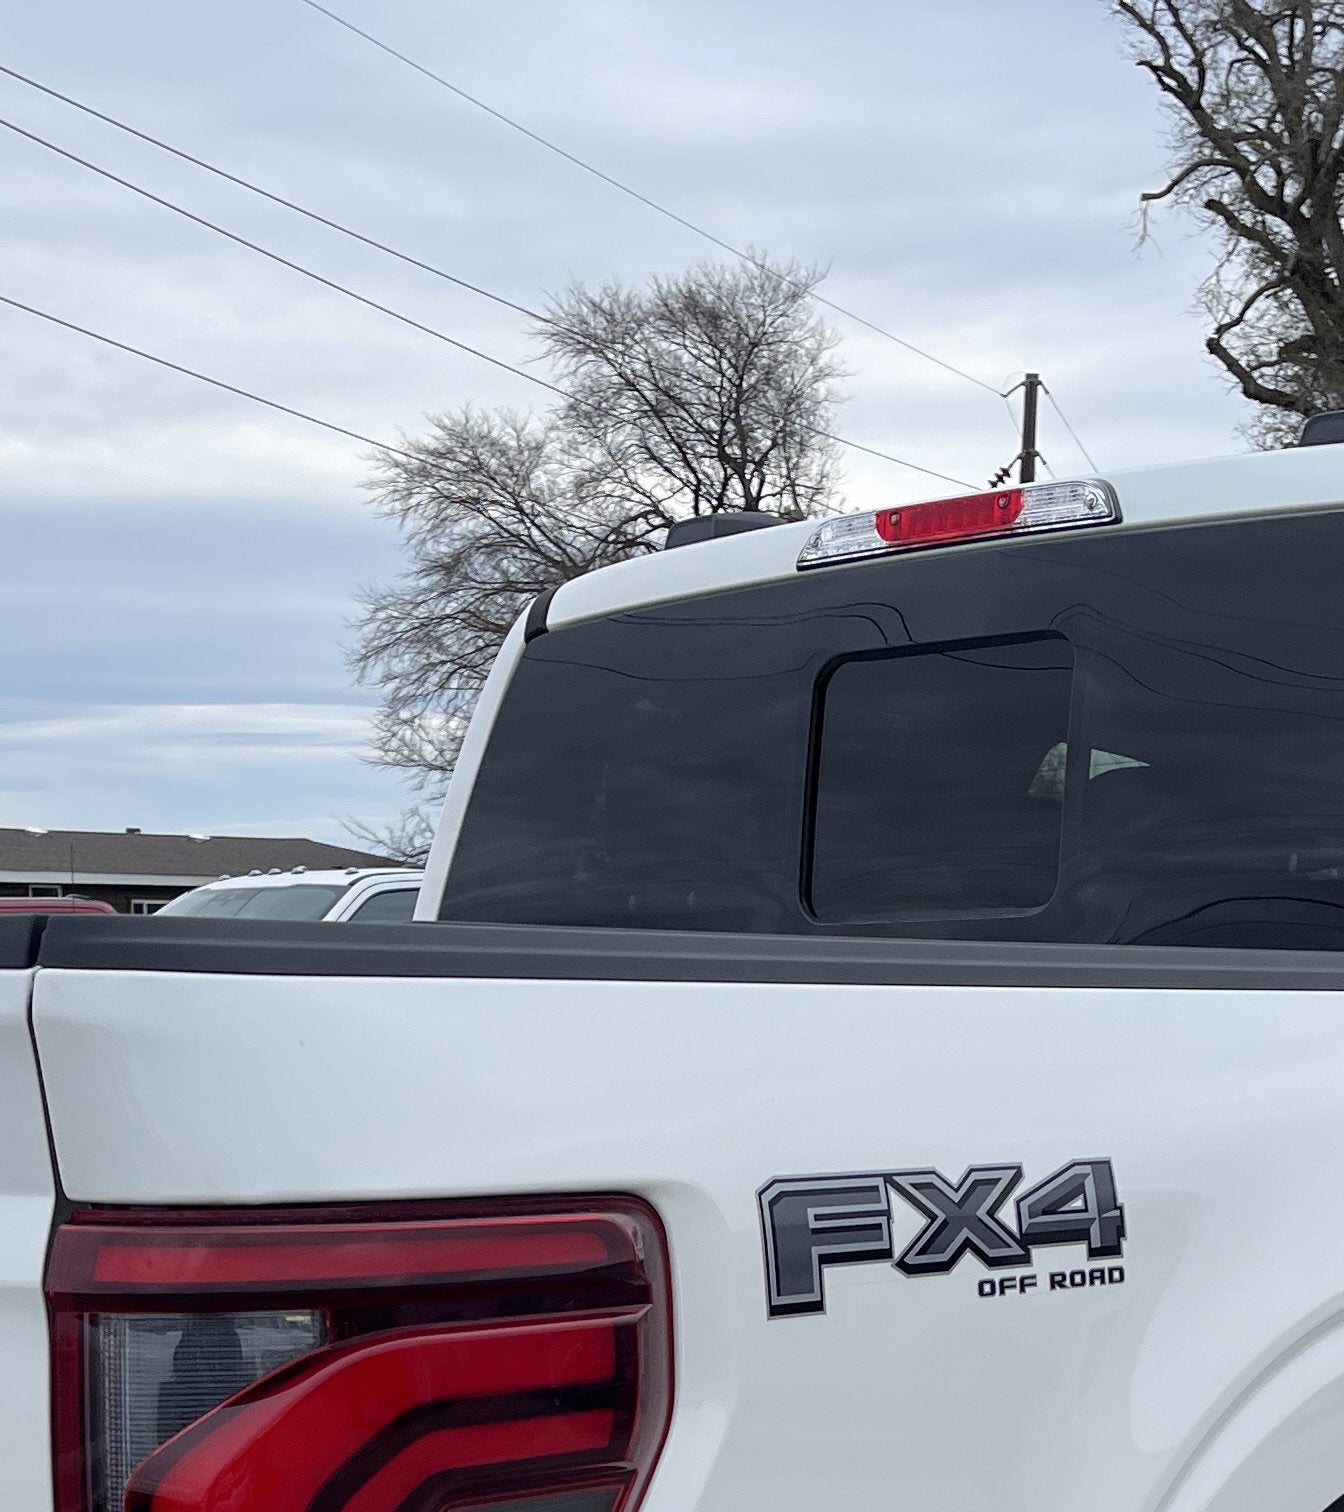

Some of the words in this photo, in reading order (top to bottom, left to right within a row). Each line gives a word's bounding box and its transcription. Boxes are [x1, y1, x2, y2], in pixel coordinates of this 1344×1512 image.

[756, 1156, 1127, 1321] FX4
[977, 1272, 1038, 1298] OFF
[1049, 1265, 1126, 1291] ROAD
